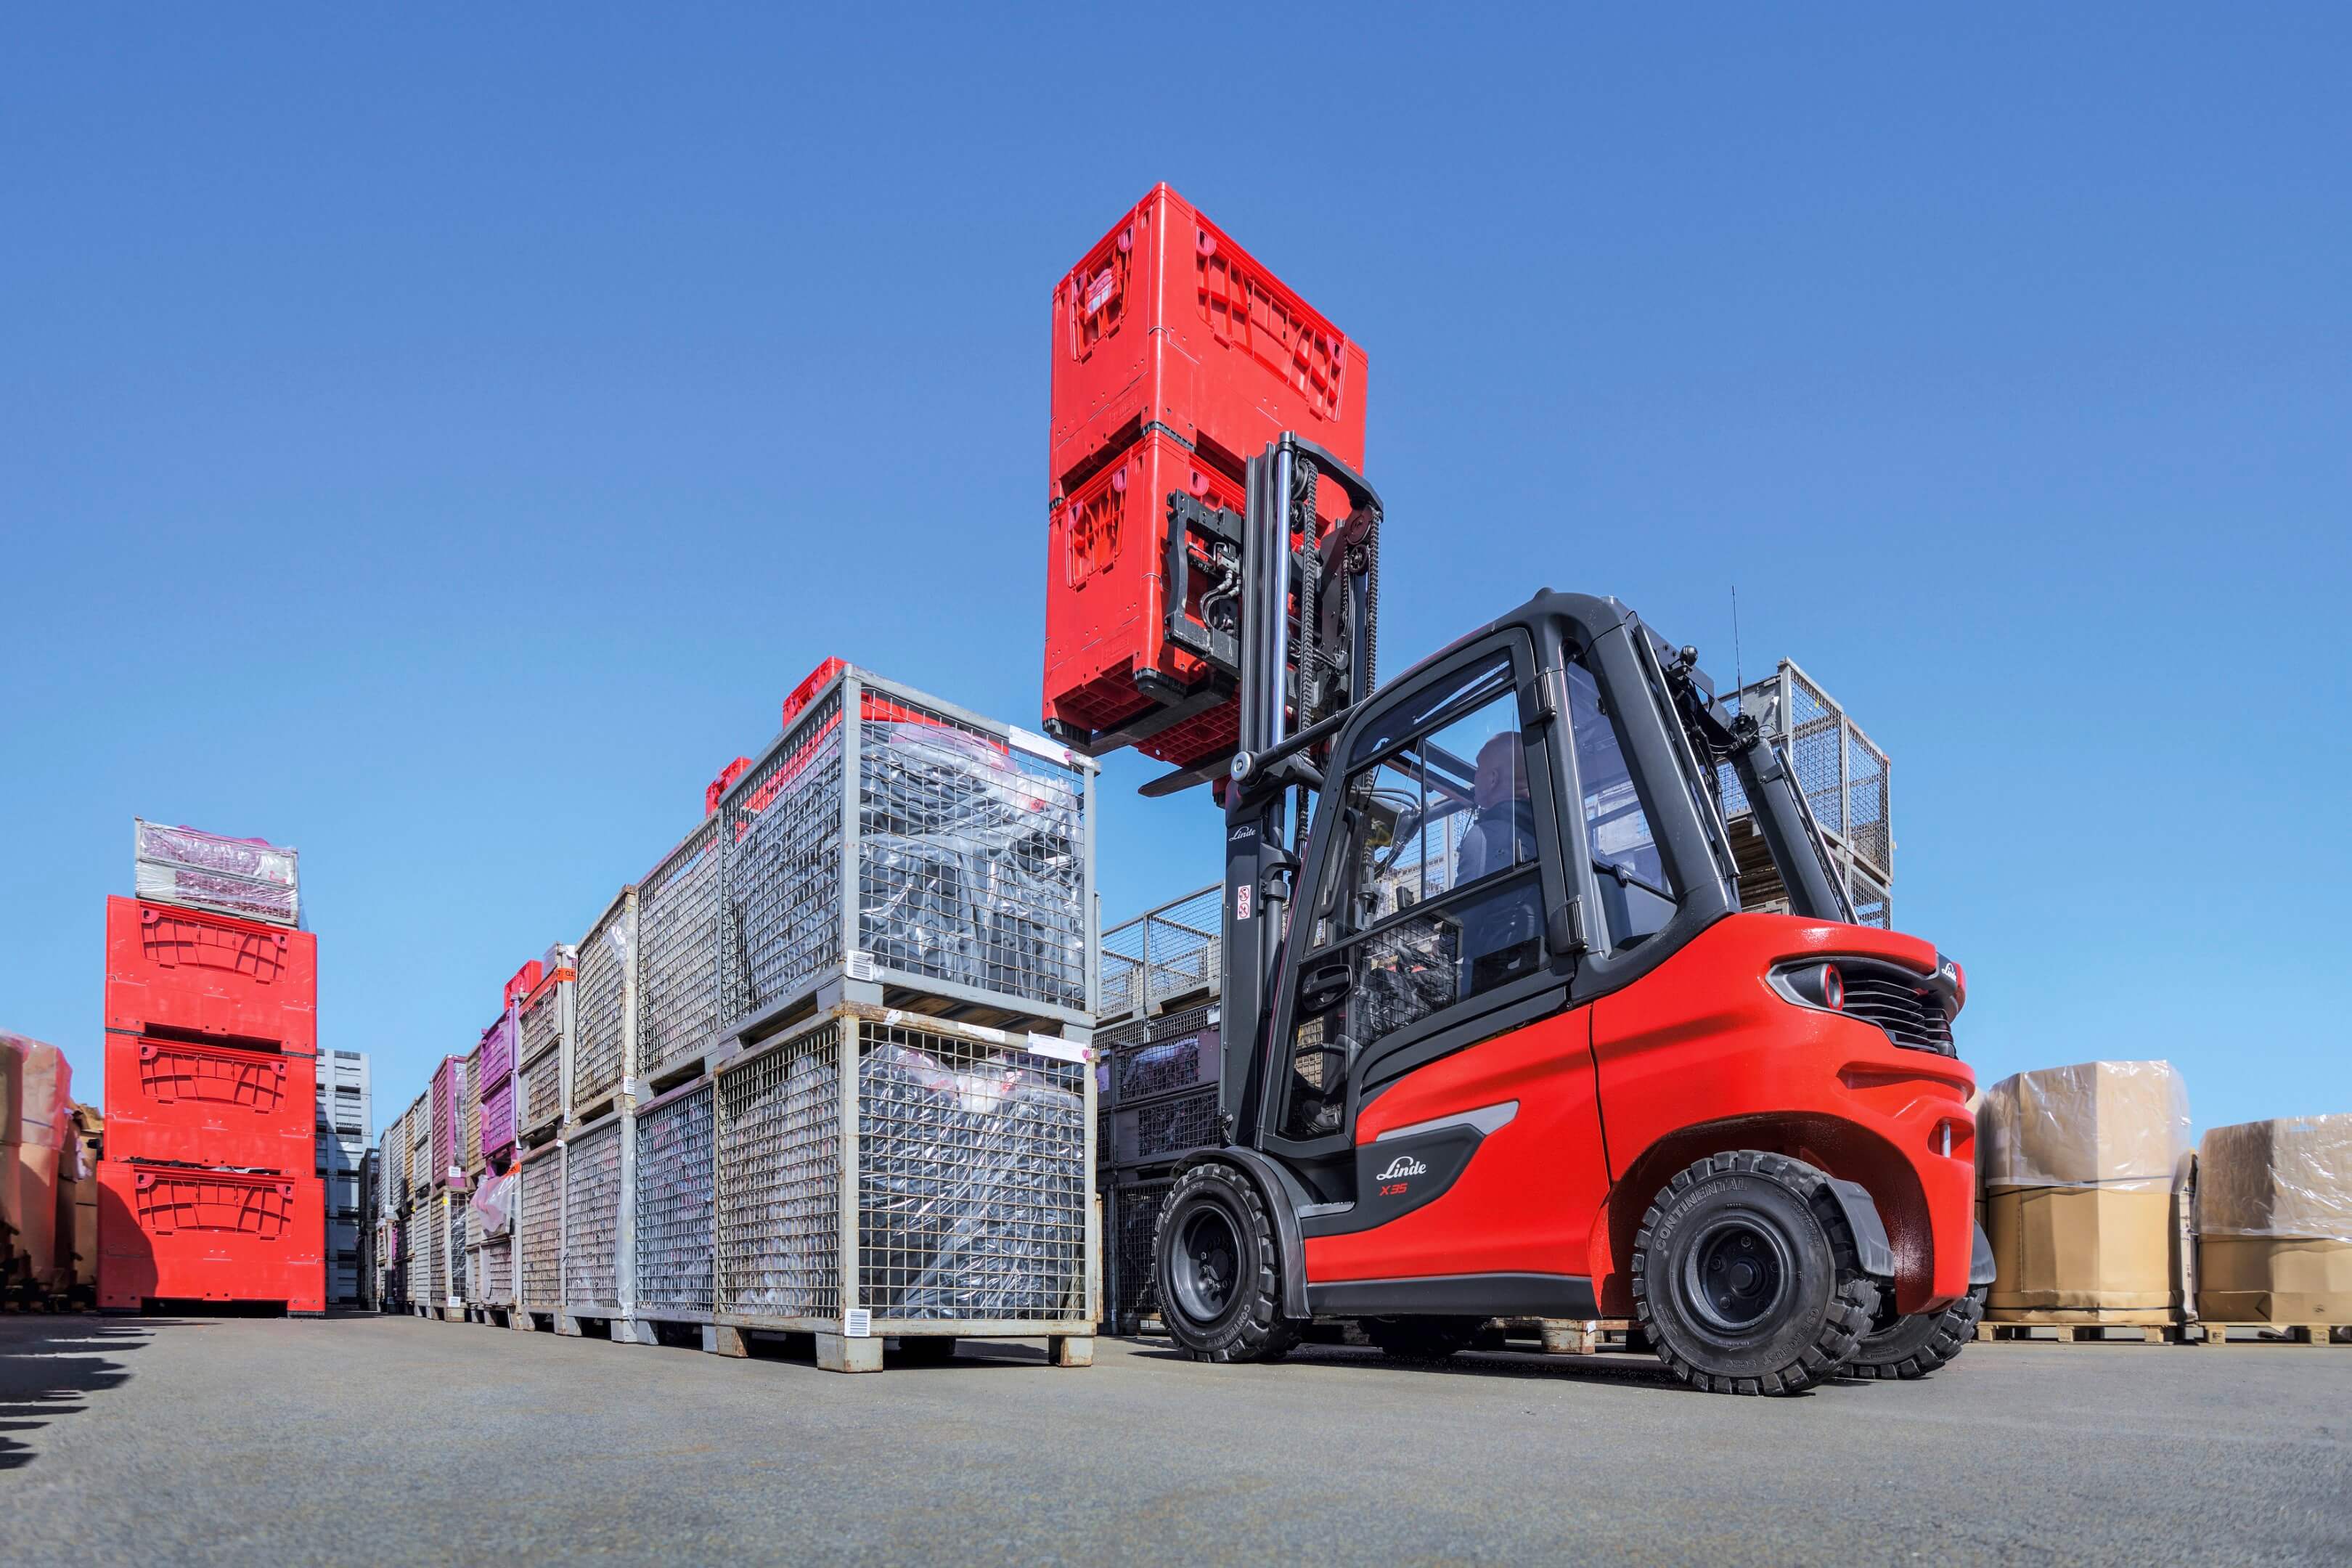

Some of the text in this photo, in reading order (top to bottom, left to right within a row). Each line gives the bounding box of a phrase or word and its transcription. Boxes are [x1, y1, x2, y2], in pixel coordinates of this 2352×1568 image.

[1228, 825, 1256, 842] Linde
[1376, 1156, 1426, 1180] Linde
[1654, 1177, 1749, 1252] CONTINENTAL
